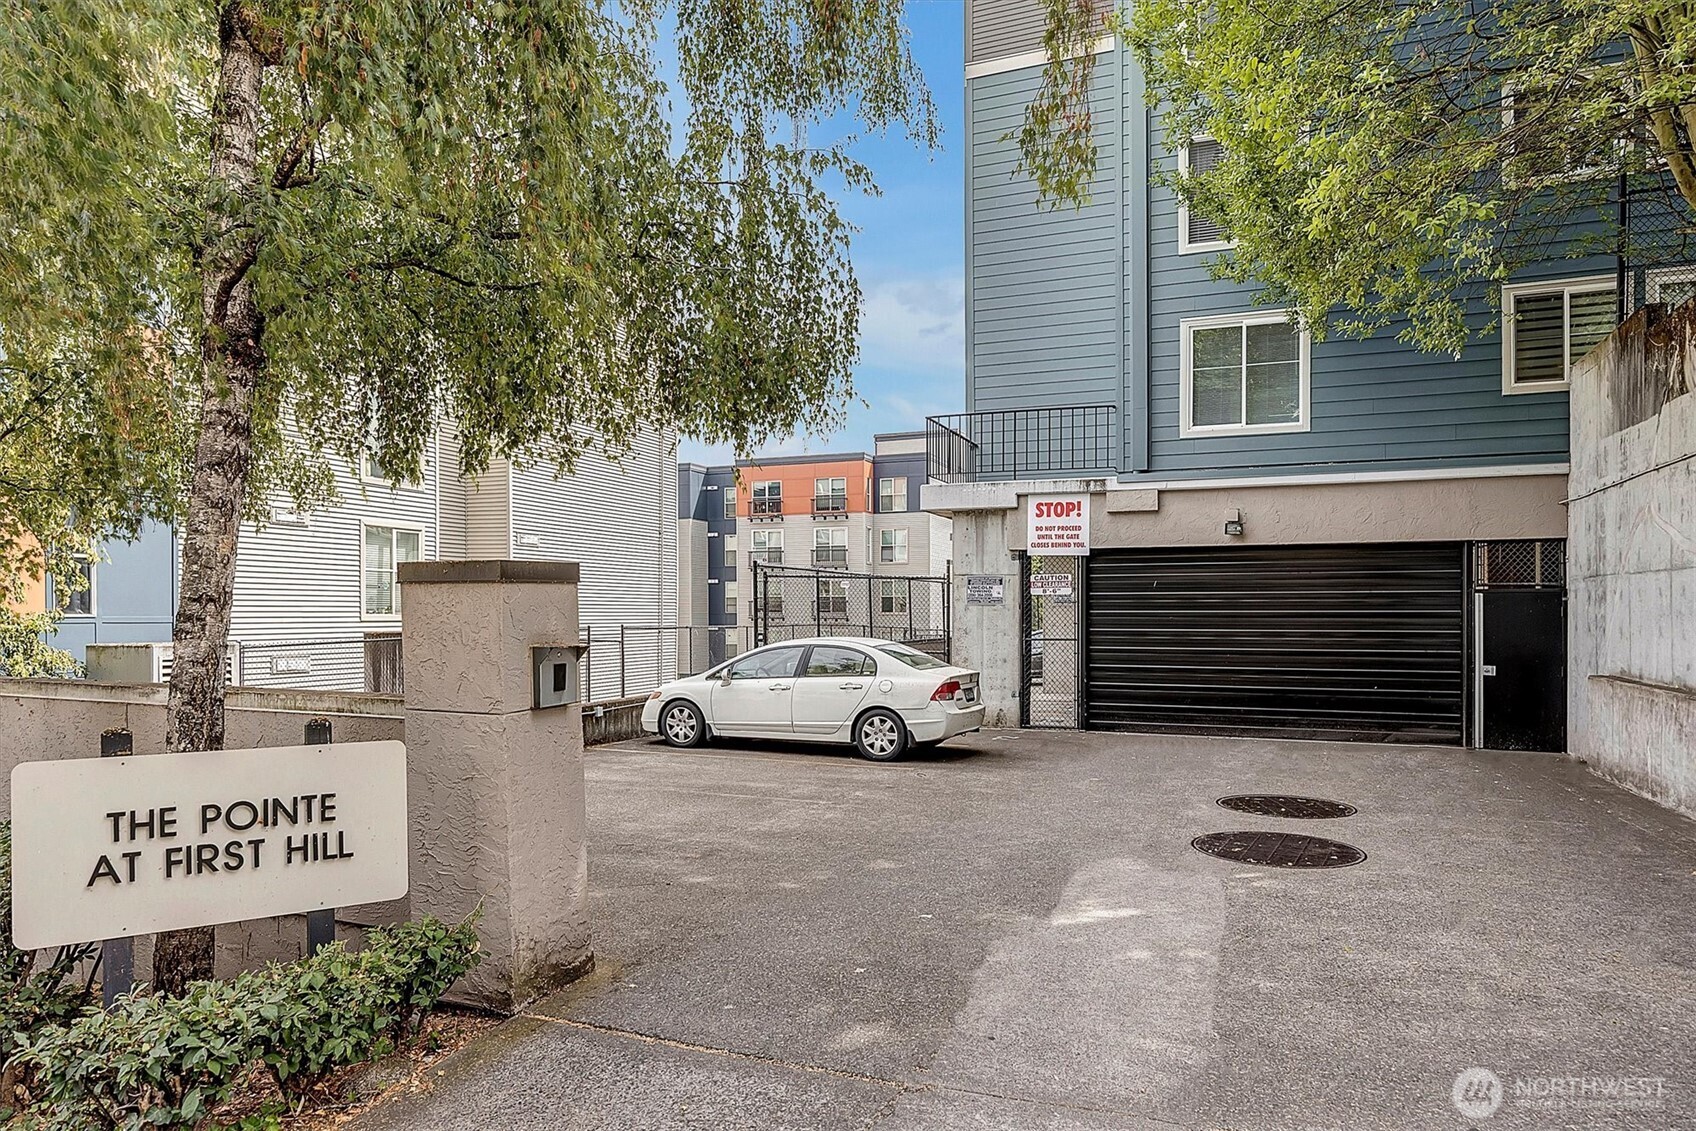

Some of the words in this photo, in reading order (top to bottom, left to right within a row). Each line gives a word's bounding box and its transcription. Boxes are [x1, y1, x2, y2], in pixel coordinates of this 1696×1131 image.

[1035, 501, 1082, 518] STOP!
[106, 806, 178, 842] THE
[201, 793, 337, 834] POINTE
[86, 851, 142, 887] AT
[165, 838, 266, 878] FIRST
[286, 831, 354, 864] HILL
